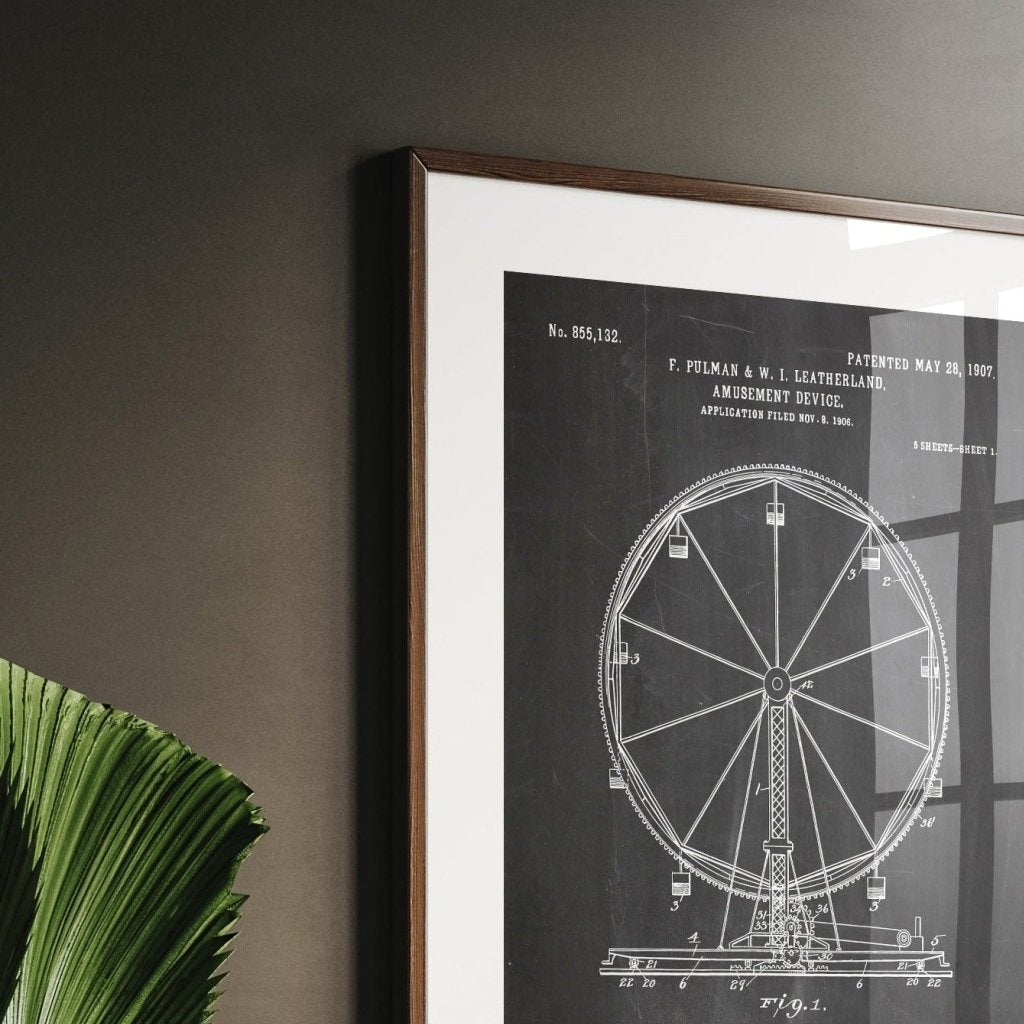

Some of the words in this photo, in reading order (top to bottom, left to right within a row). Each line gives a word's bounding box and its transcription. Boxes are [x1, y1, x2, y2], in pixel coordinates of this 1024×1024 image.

[549, 323, 568, 338] No.
[572, 325, 622, 344] 855,132.
[668, 358, 680, 372] F.
[686, 360, 738, 377] PULMAN
[744, 365, 753, 379] &
[759, 366, 774, 381] W.
[779, 368, 789, 382] I.
[847, 352, 909, 371] PATENTED
[915, 358, 941, 373] MAY
[945, 361, 962, 378] 28,
[968, 363, 996, 380] 1907.
[712, 385, 790, 403] AMUSEMENT
[700, 405, 764, 420] APPLICATION
[767, 411, 795, 422] FILED
[847, 568, 856, 581] 3
[882, 576, 891, 587] 2
[630, 653, 640, 665] 3
[815, 903, 829, 914] 36
[619, 977, 634, 988] 22
[642, 979, 656, 988] 20
[679, 976, 688, 990] 6
[856, 978, 864, 989] 6
